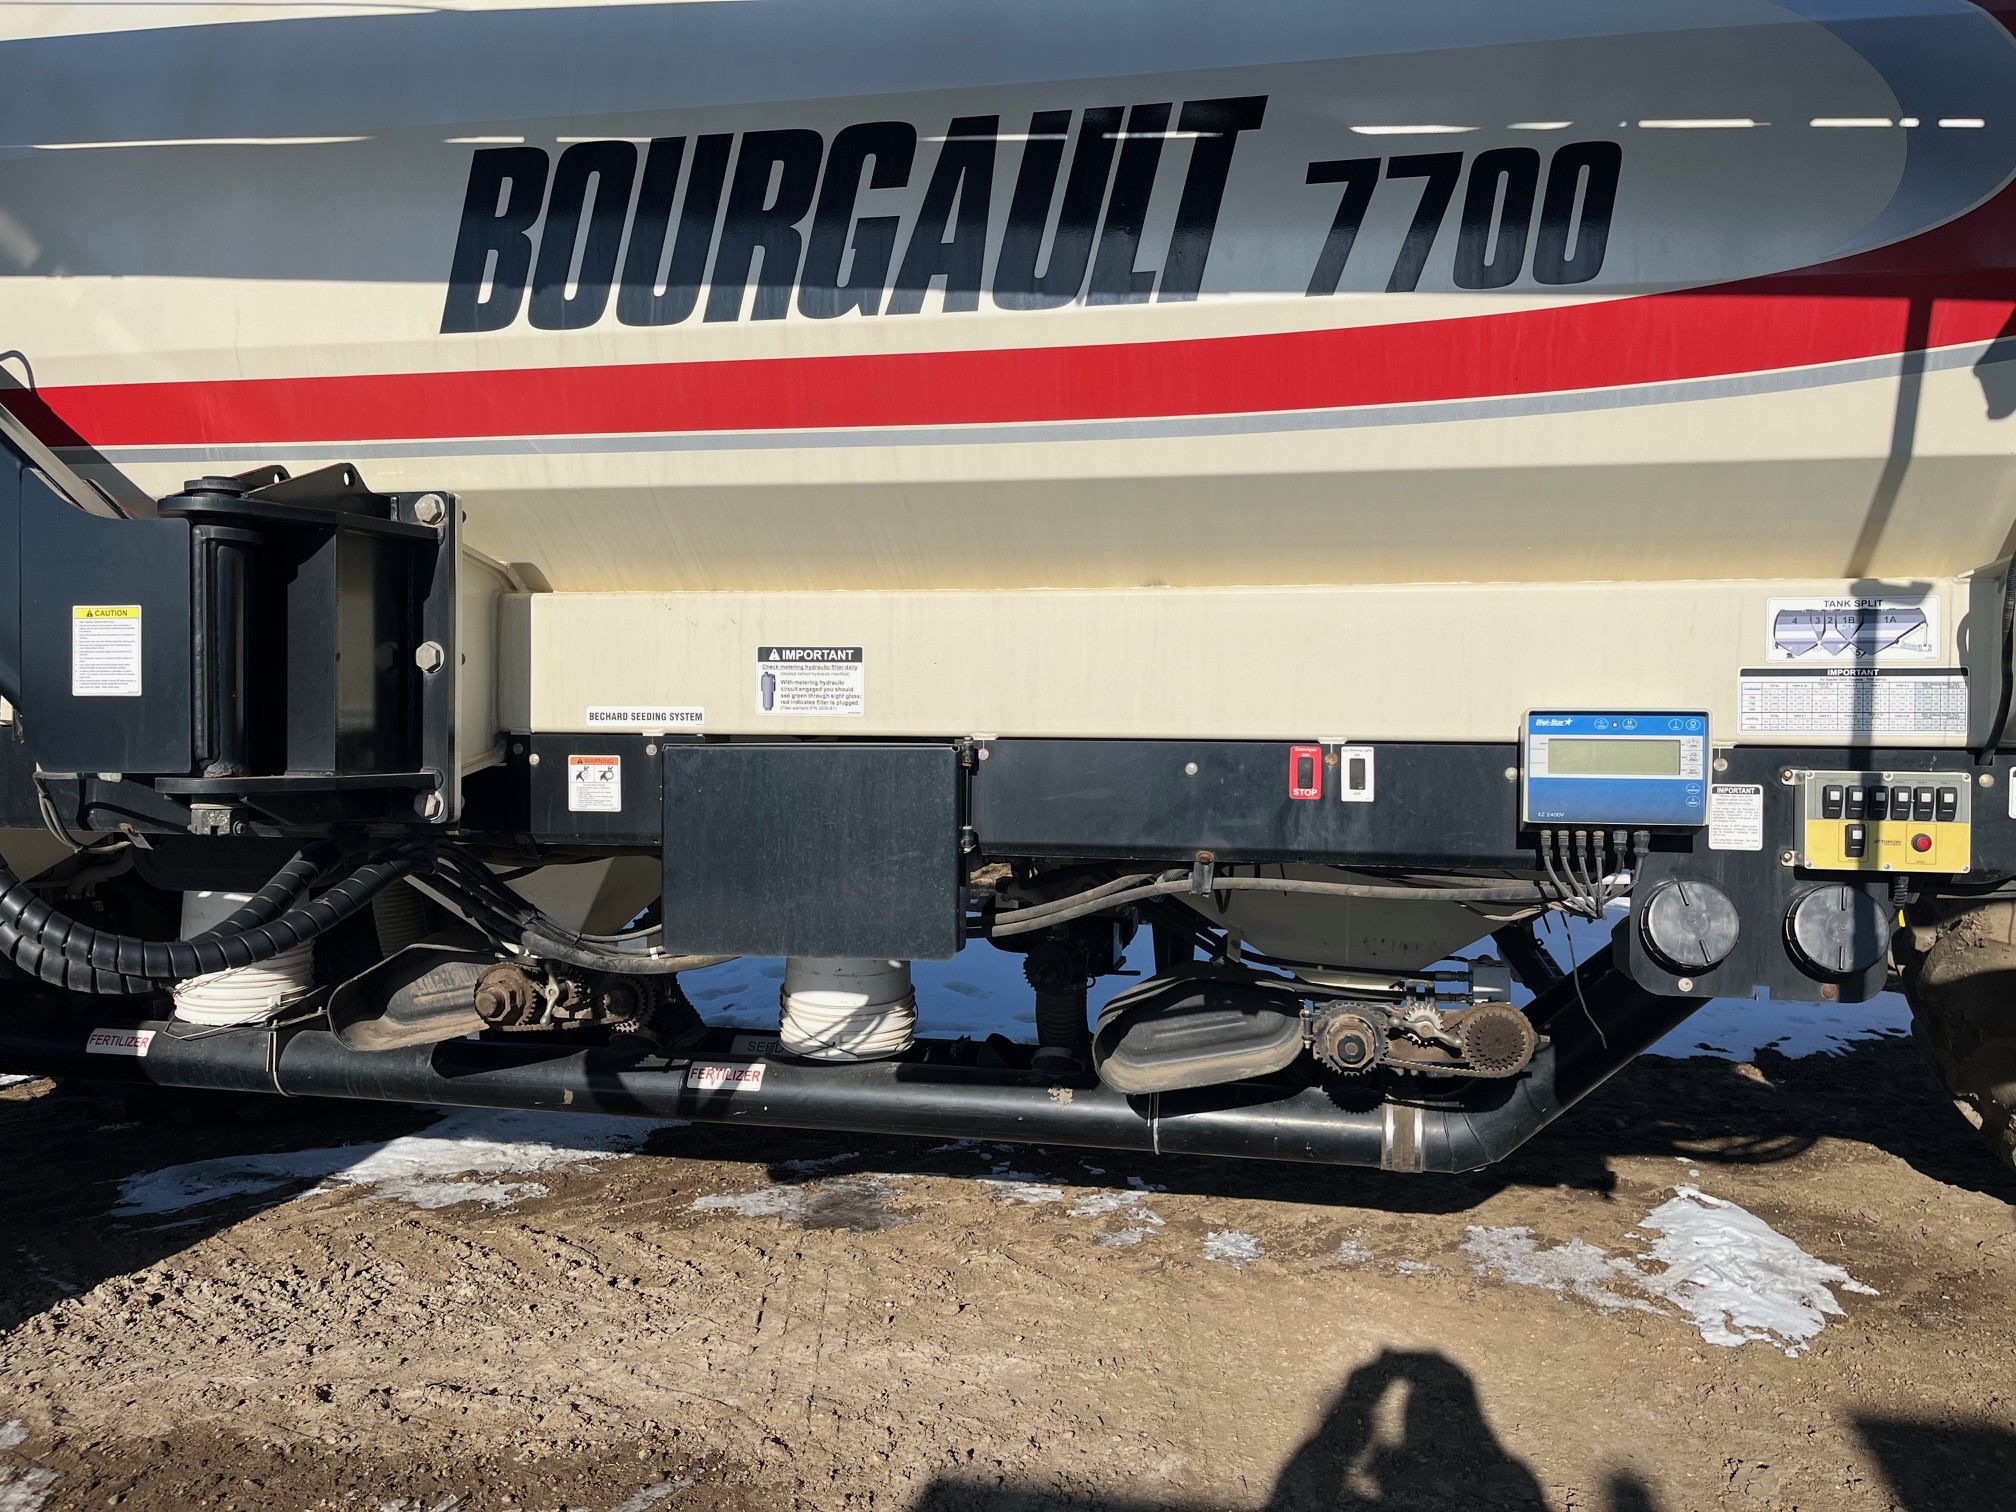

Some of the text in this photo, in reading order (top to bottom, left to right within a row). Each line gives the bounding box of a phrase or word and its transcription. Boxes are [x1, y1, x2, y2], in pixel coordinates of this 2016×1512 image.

[441, 95, 1267, 334] BOURGAULT
[1304, 141, 1621, 296] 7700
[782, 650, 854, 660] IMPORTANT
[589, 712, 702, 721] BECHARD SEEDING SYSTEM
[89, 1034, 149, 1048] FERTILIZER
[690, 1068, 761, 1082] FERTILIZER
